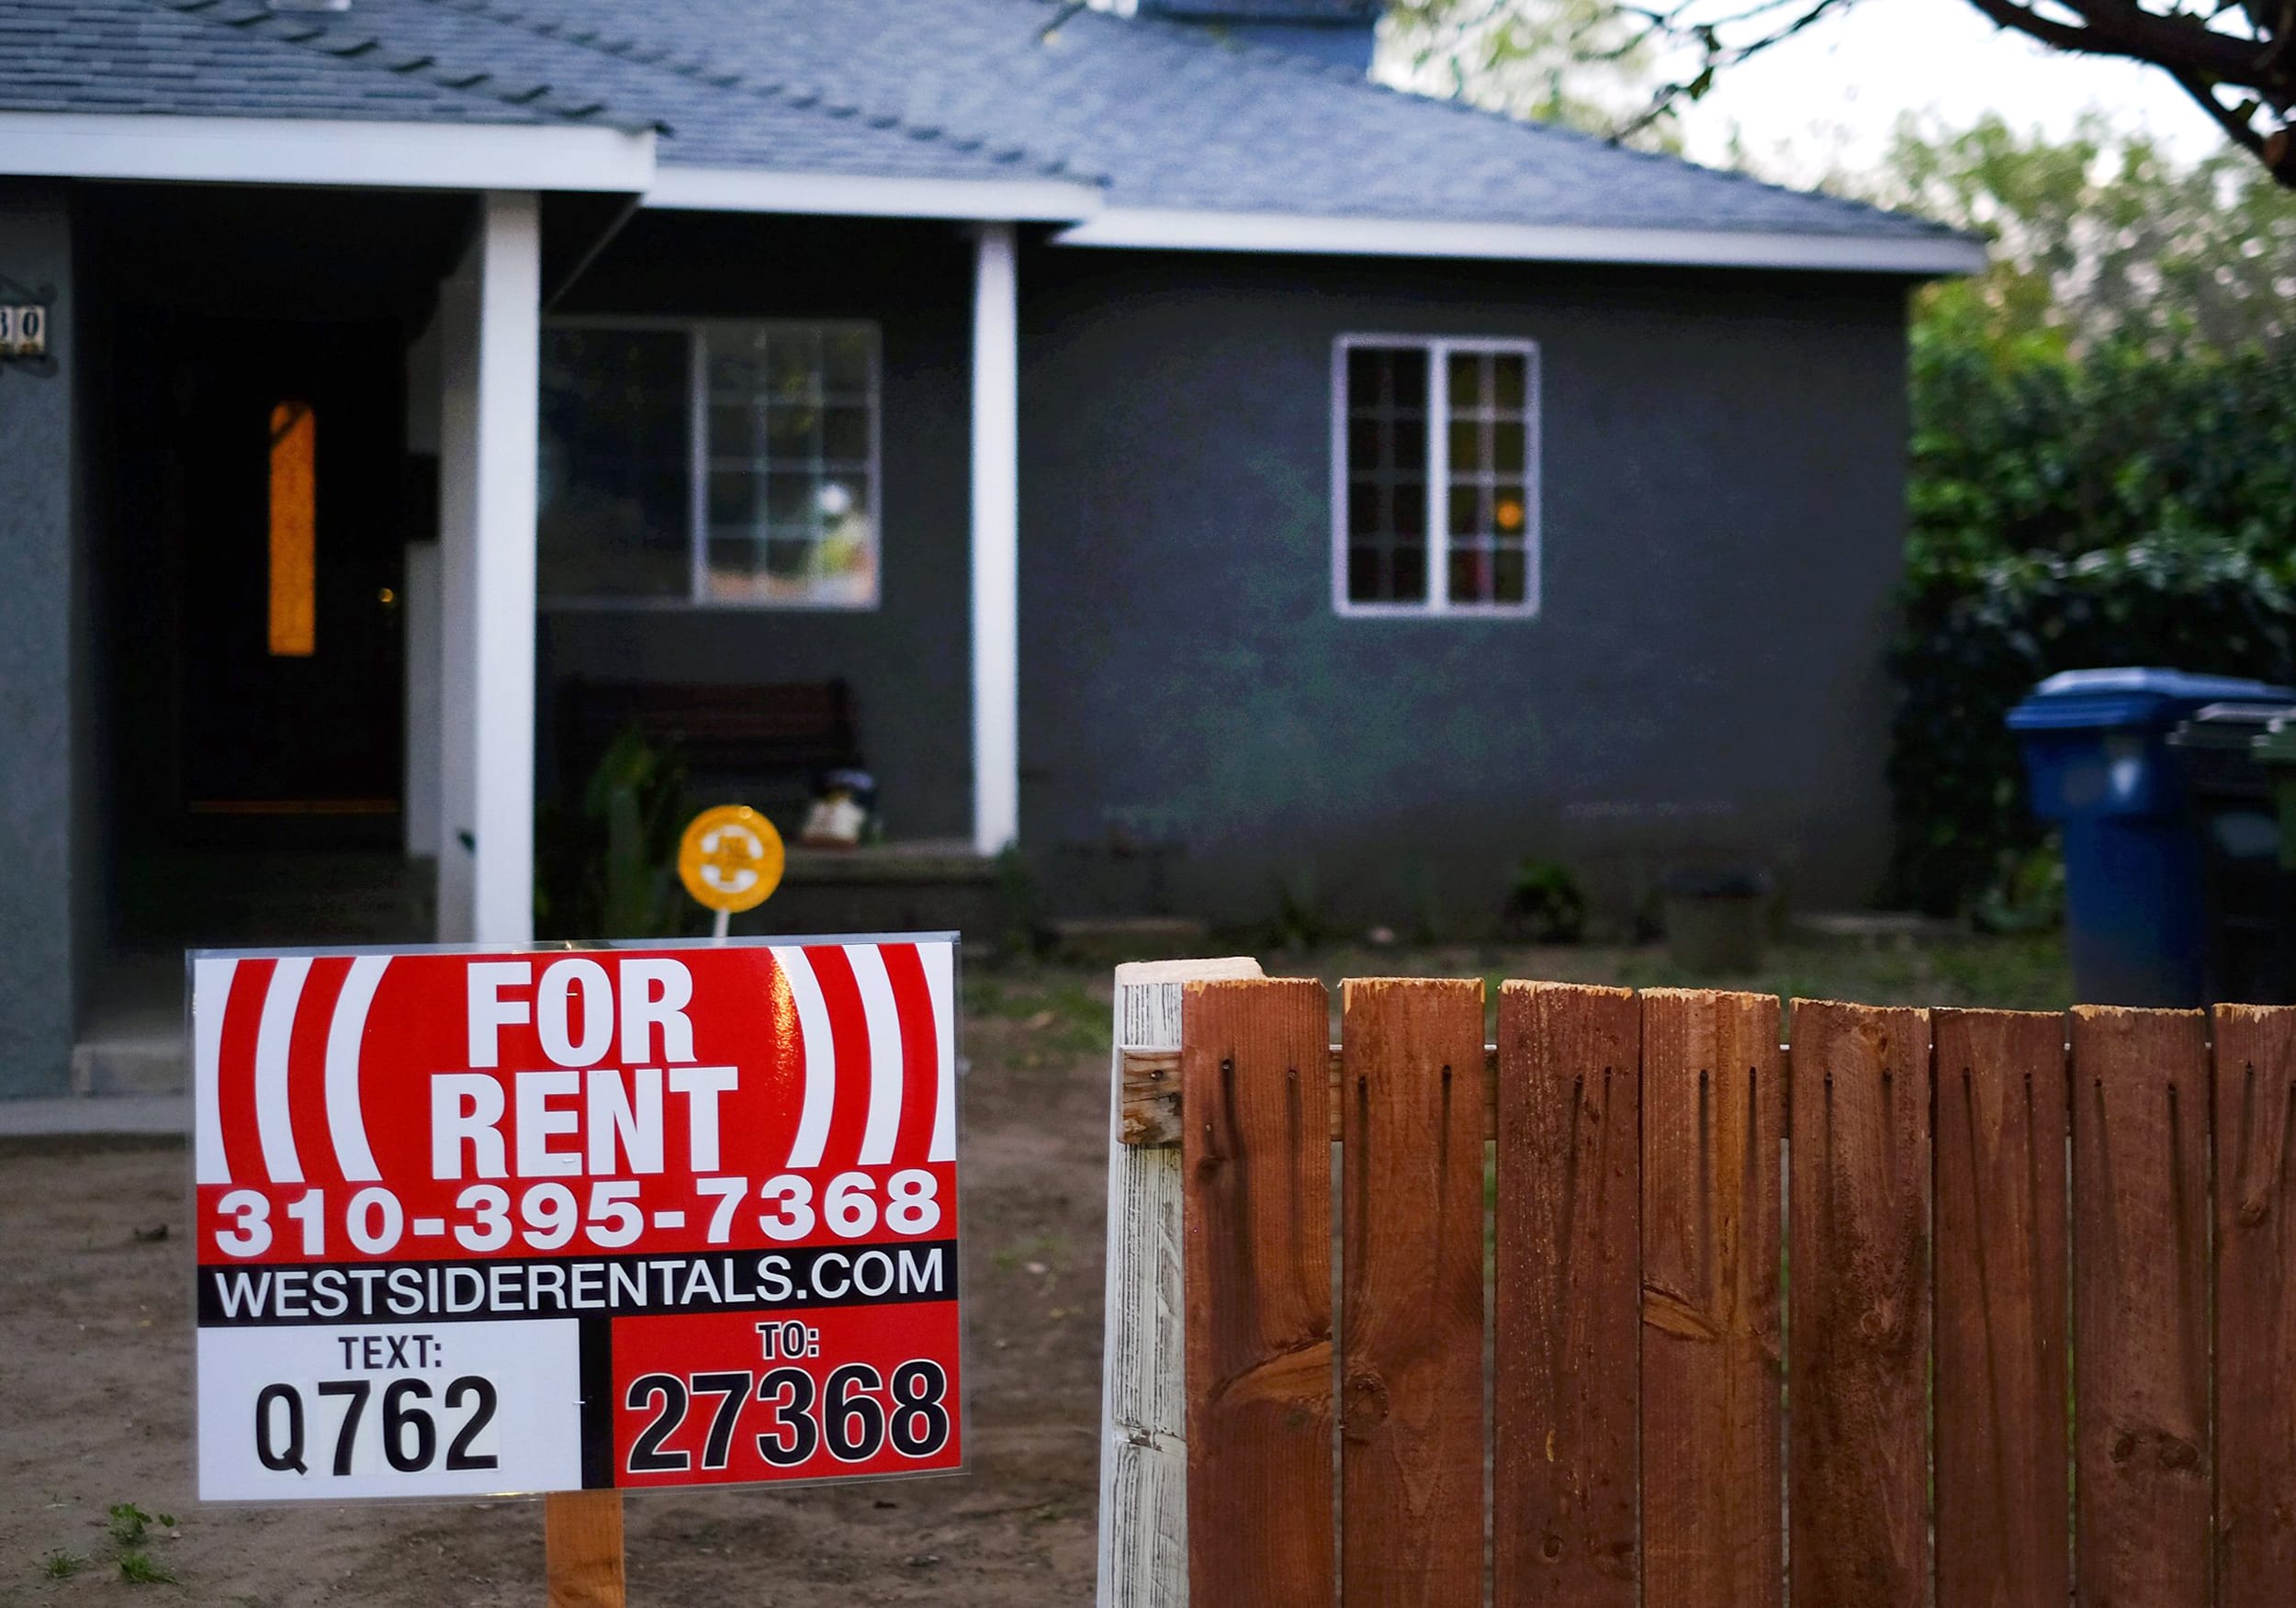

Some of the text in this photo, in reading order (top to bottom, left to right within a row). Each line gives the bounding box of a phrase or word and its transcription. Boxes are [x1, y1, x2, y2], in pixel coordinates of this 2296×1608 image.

[467, 958, 698, 1067] FOR
[431, 1066, 738, 1180] RENT
[215, 1169, 940, 1258] 310-395-7368
[215, 1248, 944, 1319] WESTSIDERENTALS.COM
[338, 1334, 443, 1369] TEXT:
[756, 1321, 819, 1359] TO:
[255, 1376, 499, 1477] Q762
[625, 1359, 950, 1474] 27368
